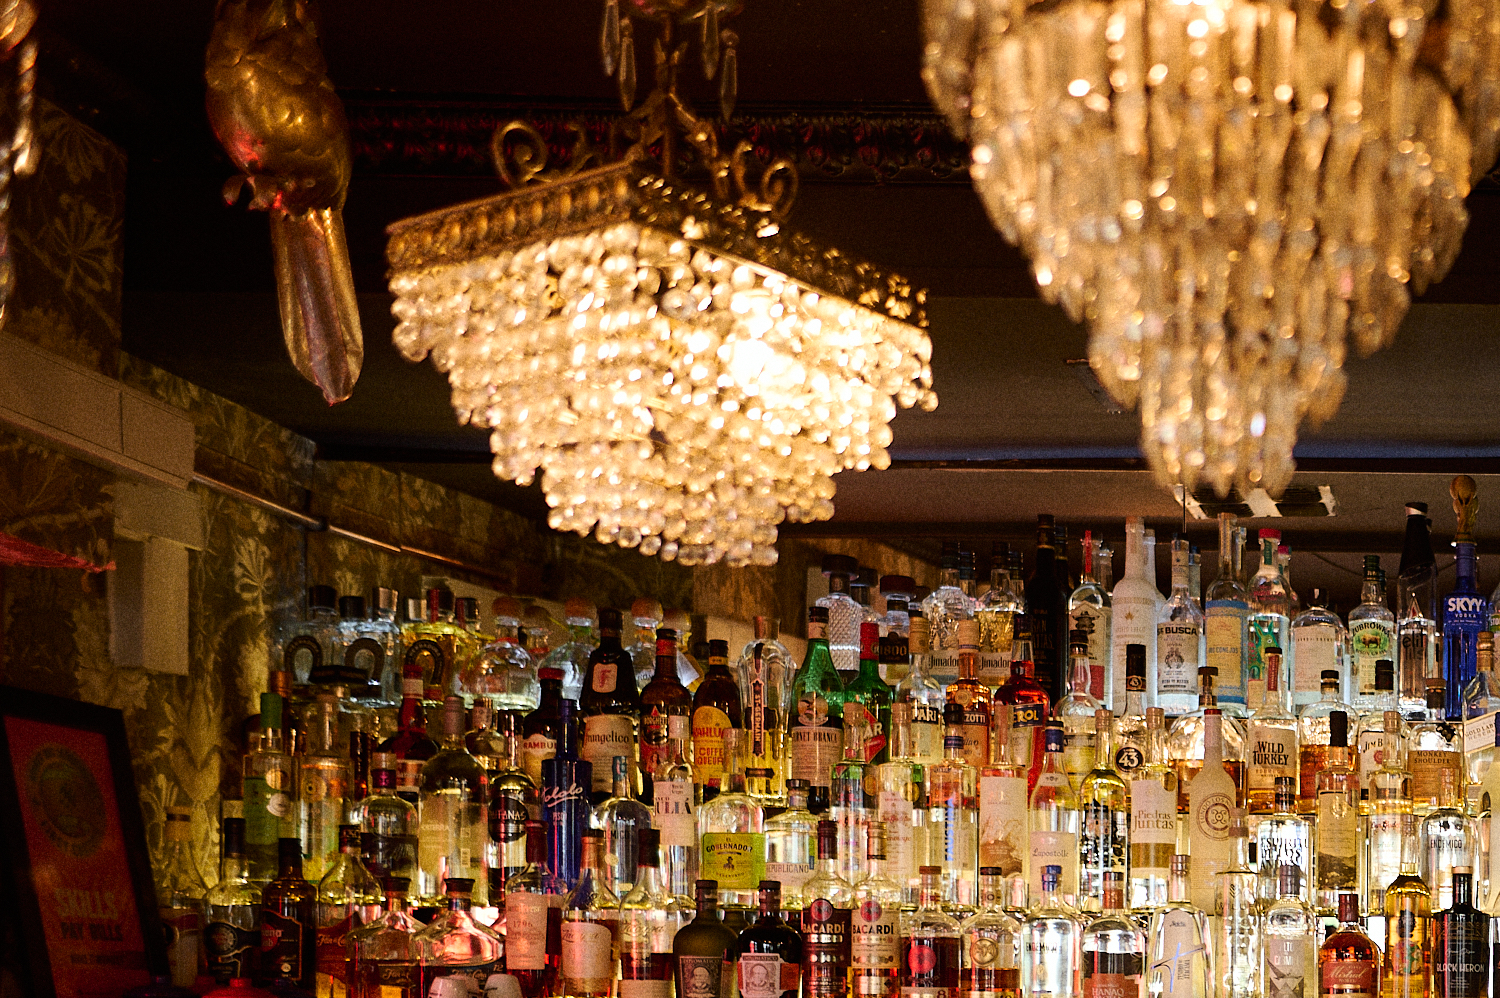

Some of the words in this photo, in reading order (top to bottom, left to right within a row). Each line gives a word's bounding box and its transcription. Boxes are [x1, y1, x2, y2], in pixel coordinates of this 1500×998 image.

[1448, 598, 1483, 612] SKYY
[1165, 626, 1198, 636] BUSCA
[1257, 742, 1284, 754] WILD
[1119, 751, 1139, 768] 43
[1253, 750, 1289, 766] TURKEY
[1138, 810, 1171, 819] Piedras
[1133, 815, 1174, 832] Juntas
[852, 921, 894, 935] BACARDÍ
[1436, 963, 1458, 973] BLACK
[1459, 963, 1485, 973] HERON
